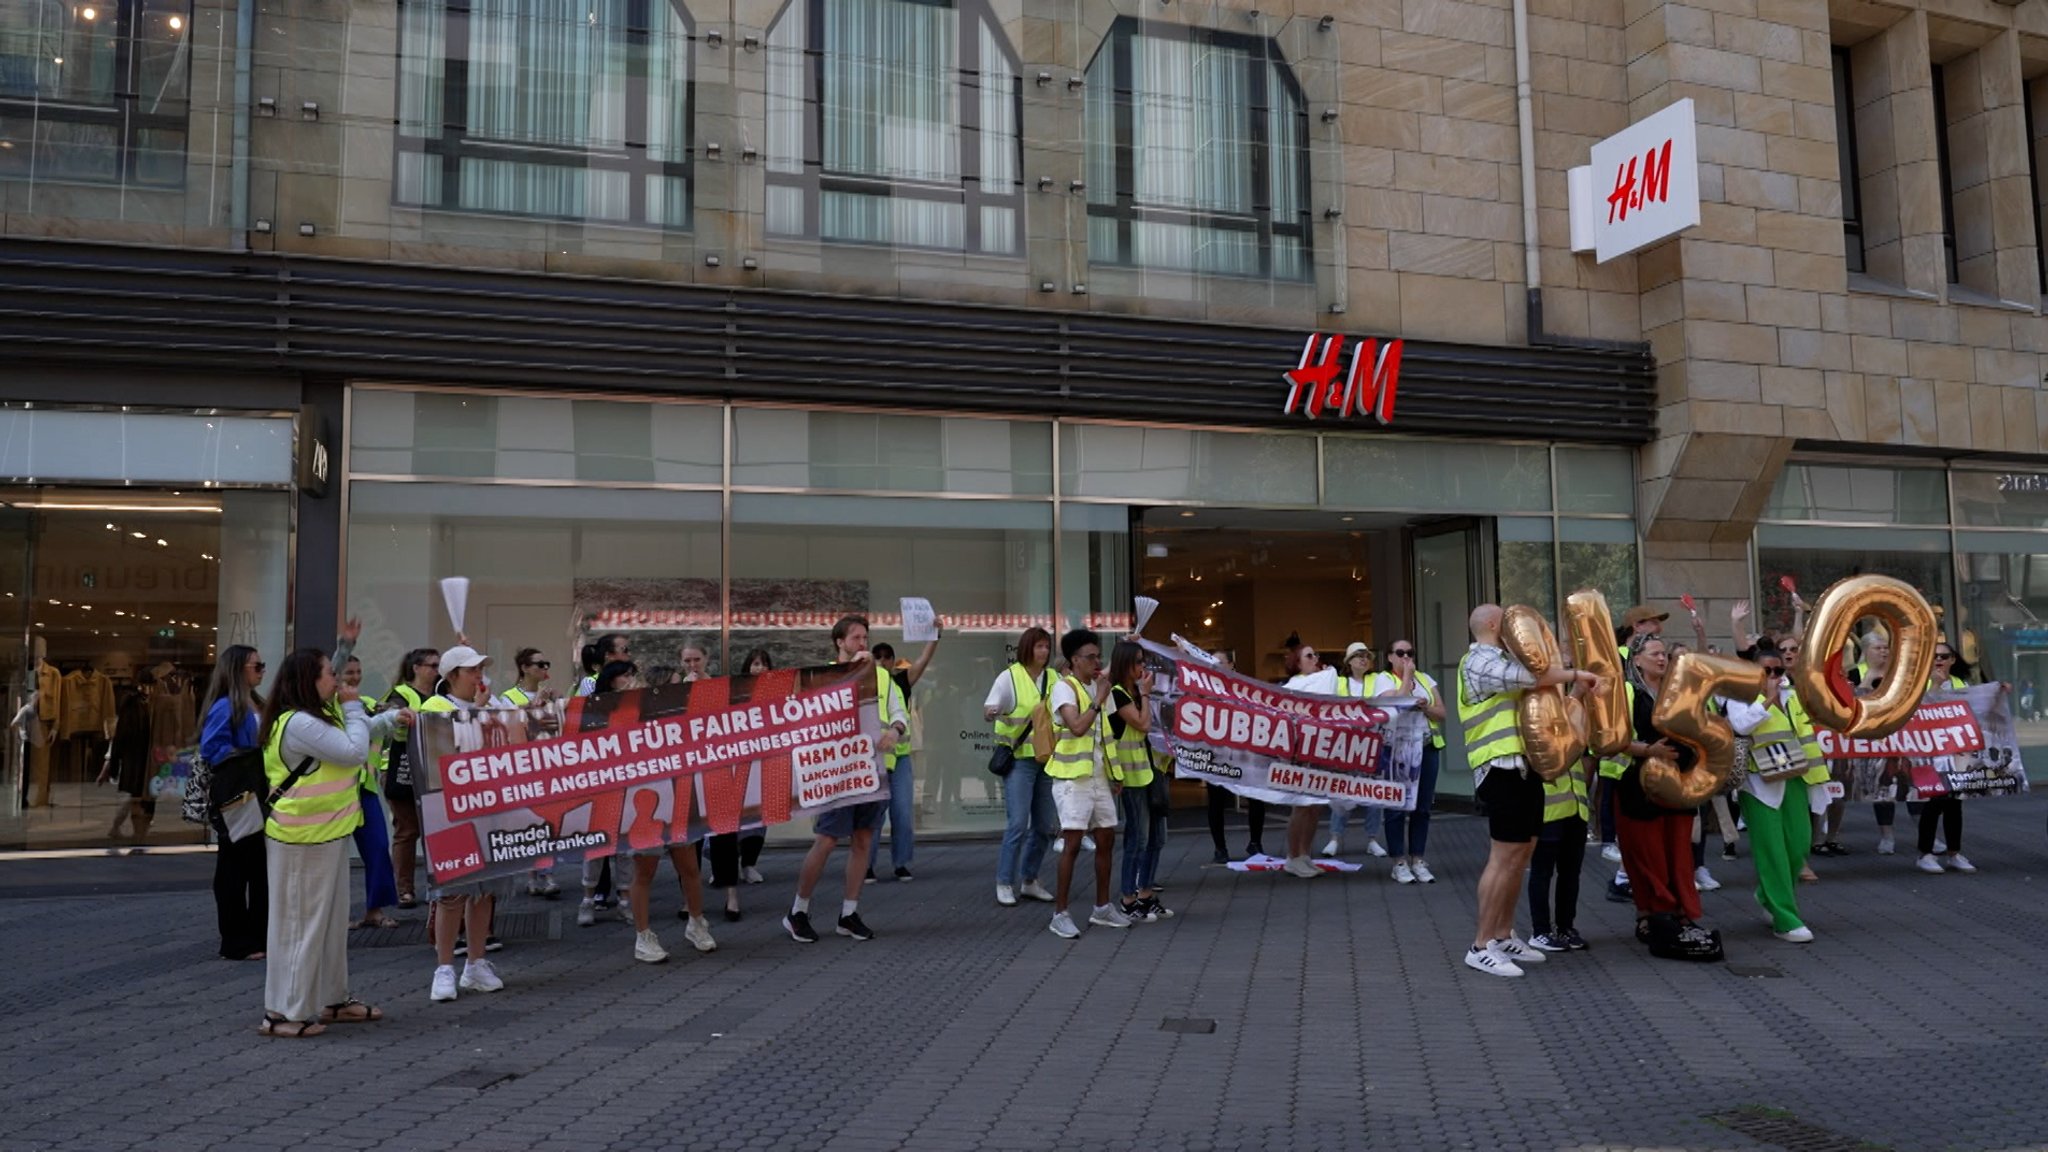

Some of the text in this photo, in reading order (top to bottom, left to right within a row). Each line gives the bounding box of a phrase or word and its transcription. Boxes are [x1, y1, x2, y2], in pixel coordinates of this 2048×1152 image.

[1607, 138, 1672, 226] H&M
[1282, 332, 1404, 425] H&M
[1180, 666, 1231, 697] MIR
[448, 734, 622, 786] GEMEINSAM
[627, 719, 683, 753] FÜR
[690, 705, 764, 742] FAIRE
[769, 686, 854, 725] LÖHNE
[1180, 701, 1379, 768] SUBBA TEAM!
[1838, 724, 1980, 753] VERKAUFT!
[451, 717, 856, 814] UND EINE ANGEMESSENE FLÄCHENBESETZUNG!
[798, 746, 836, 767] H&M
[1176, 747, 1212, 760] Handel
[803, 775, 874, 802] NÜRNBERG
[1270, 767, 1304, 786] H&M
[1330, 778, 1403, 801] ERLANGEN
[490, 825, 551, 847] Handel
[493, 832, 606, 862] Mittelfranken
